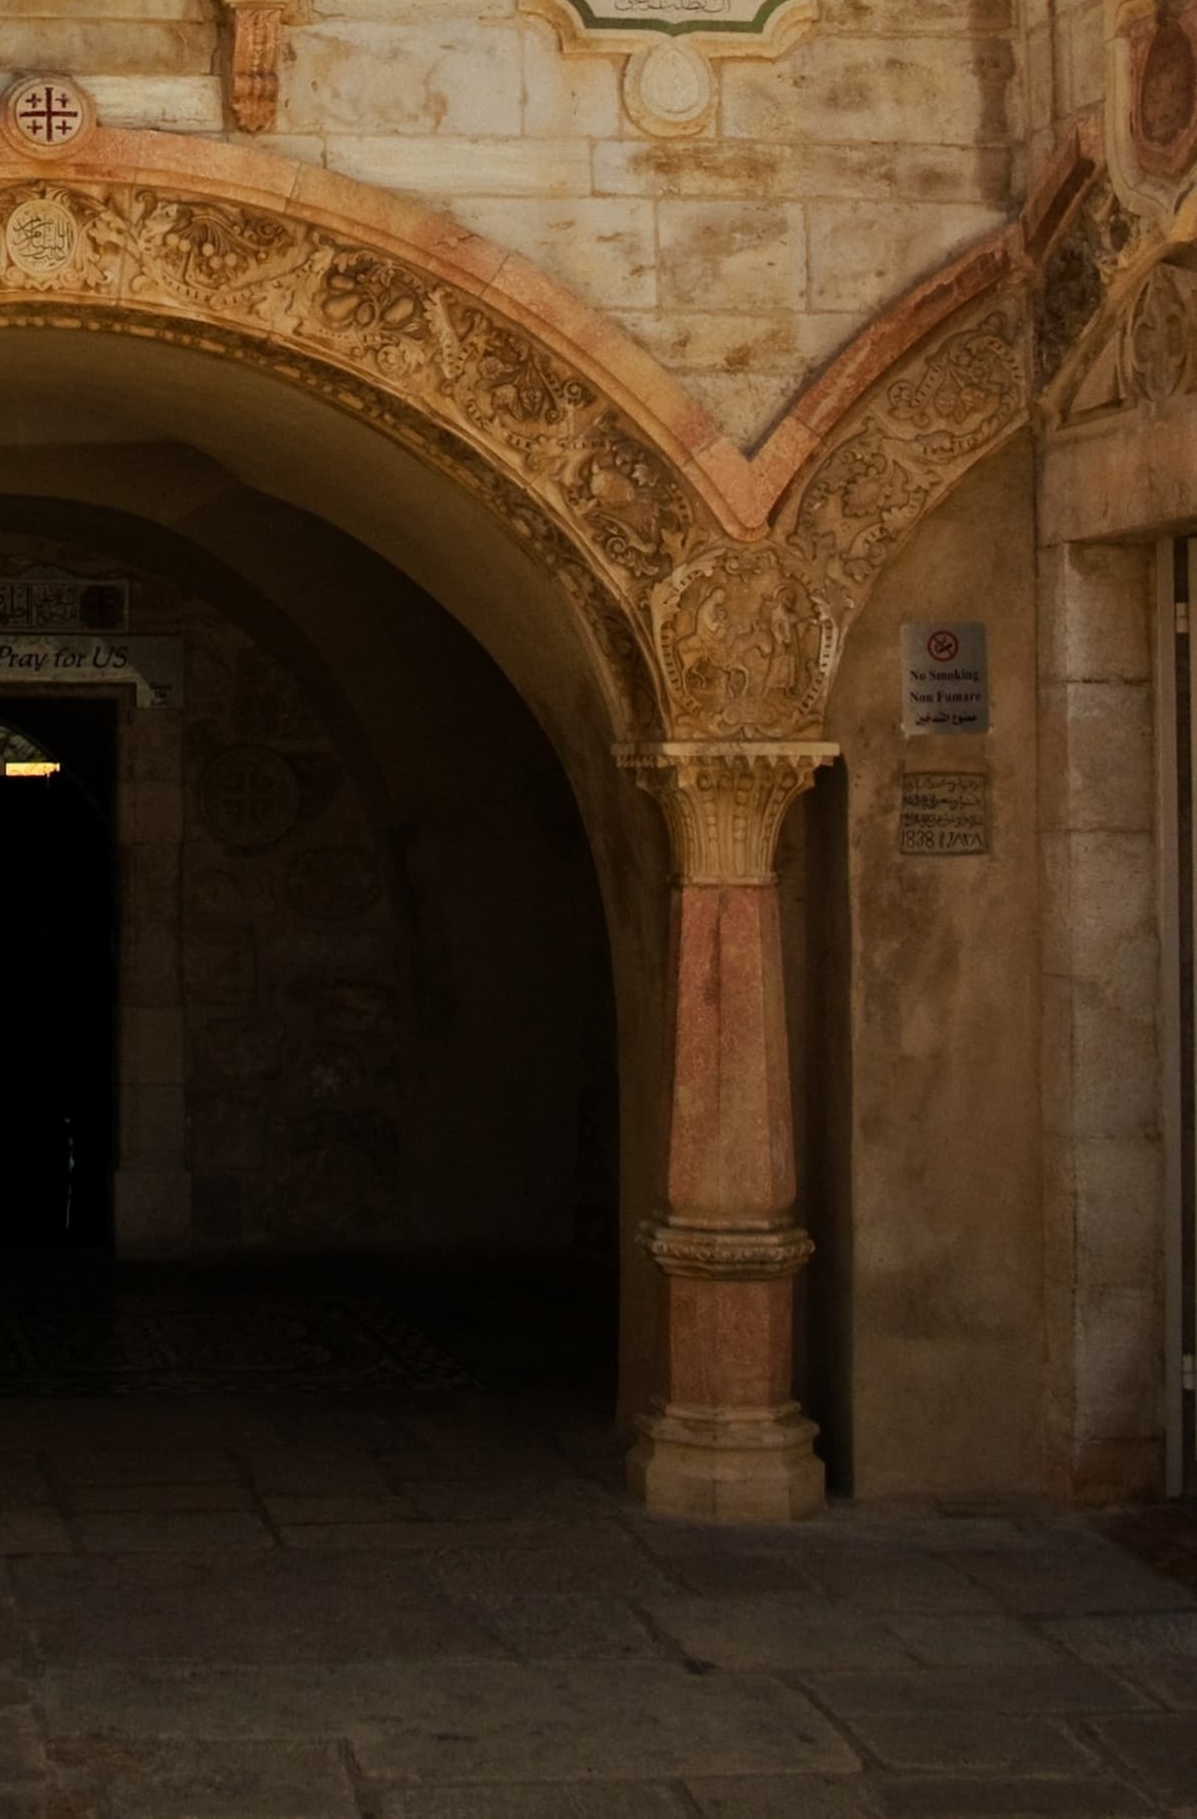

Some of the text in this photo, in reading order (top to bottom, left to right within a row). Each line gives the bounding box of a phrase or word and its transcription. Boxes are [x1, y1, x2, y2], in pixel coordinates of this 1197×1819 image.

[53, 645, 87, 668] for
[92, 645, 129, 668] US
[909, 669, 980, 683] No Smoking
[909, 690, 982, 704] Non Fumare
